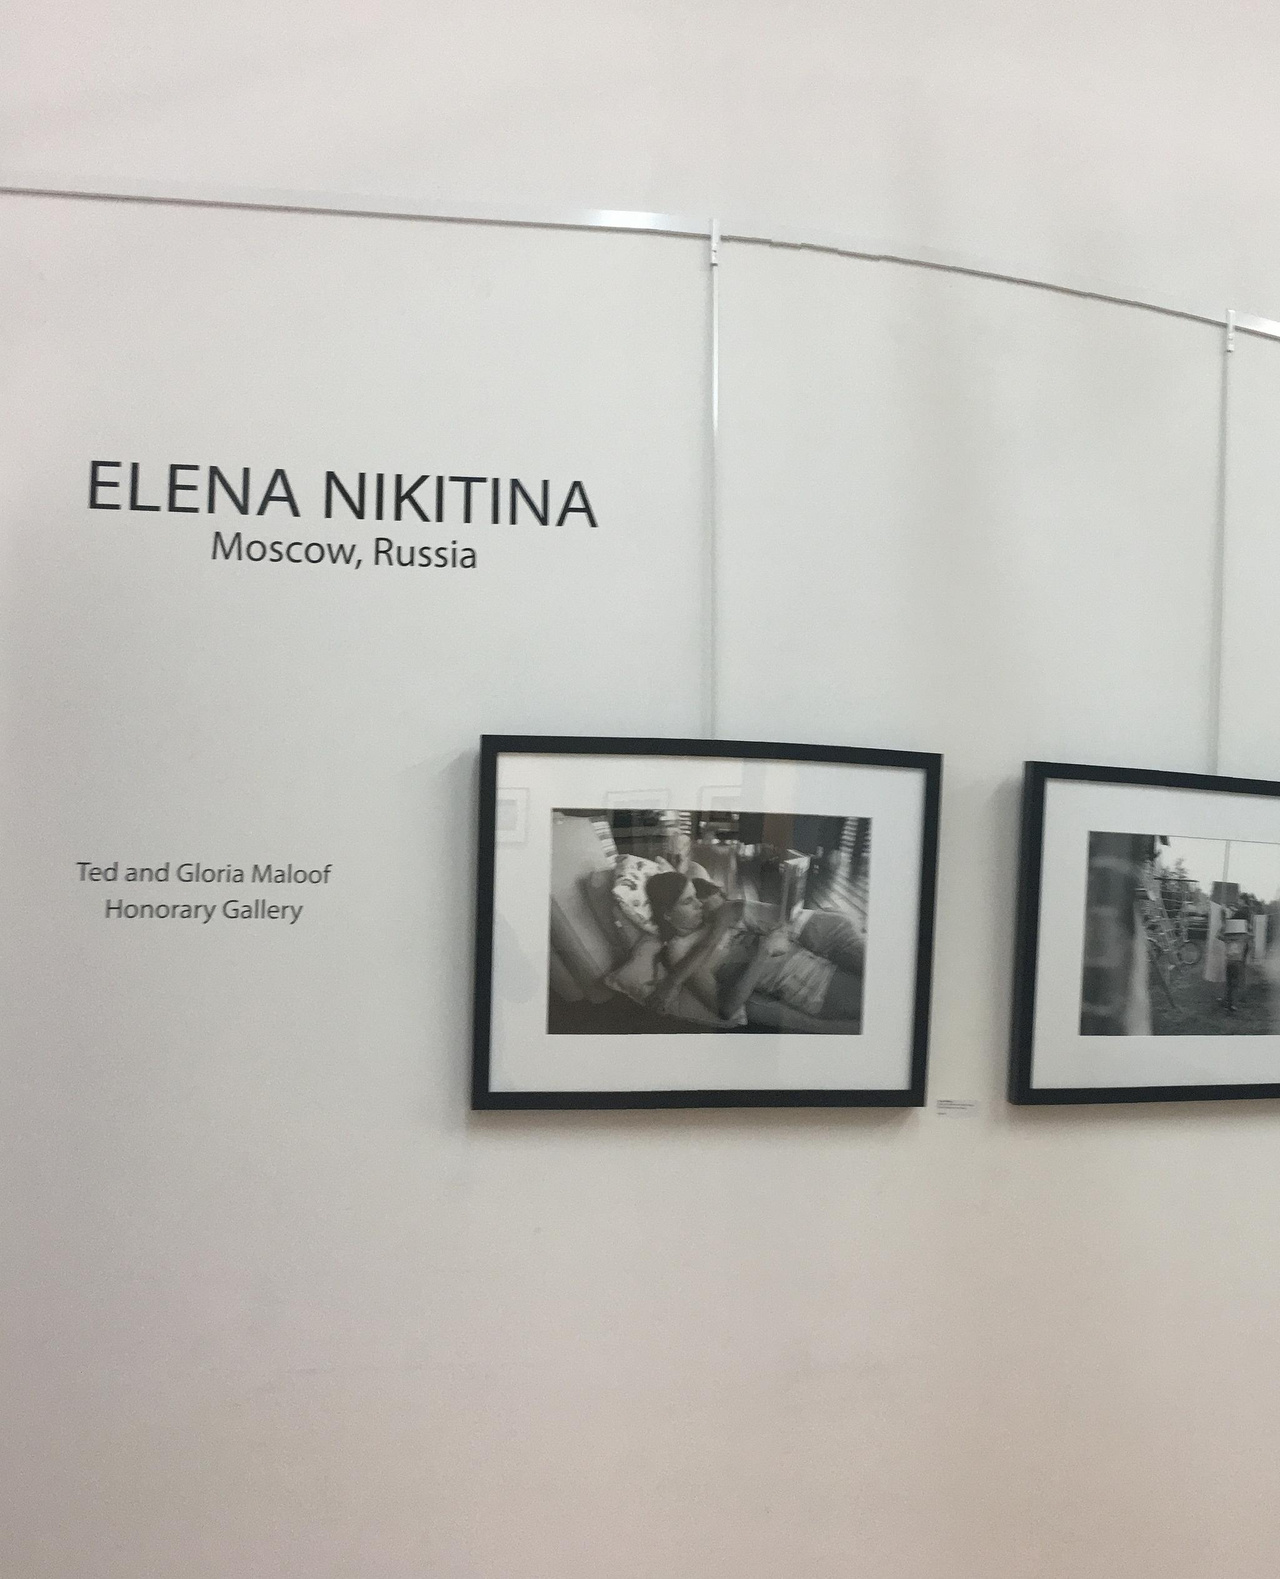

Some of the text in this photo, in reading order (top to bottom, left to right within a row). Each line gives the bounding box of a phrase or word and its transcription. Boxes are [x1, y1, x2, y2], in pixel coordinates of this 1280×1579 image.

[88, 460, 599, 528] ELENA NIKITINA
[211, 531, 477, 570] Moscow, Russia
[76, 861, 333, 884] Ted and Gloria Maloof
[104, 898, 304, 925] Honorary Gallery
